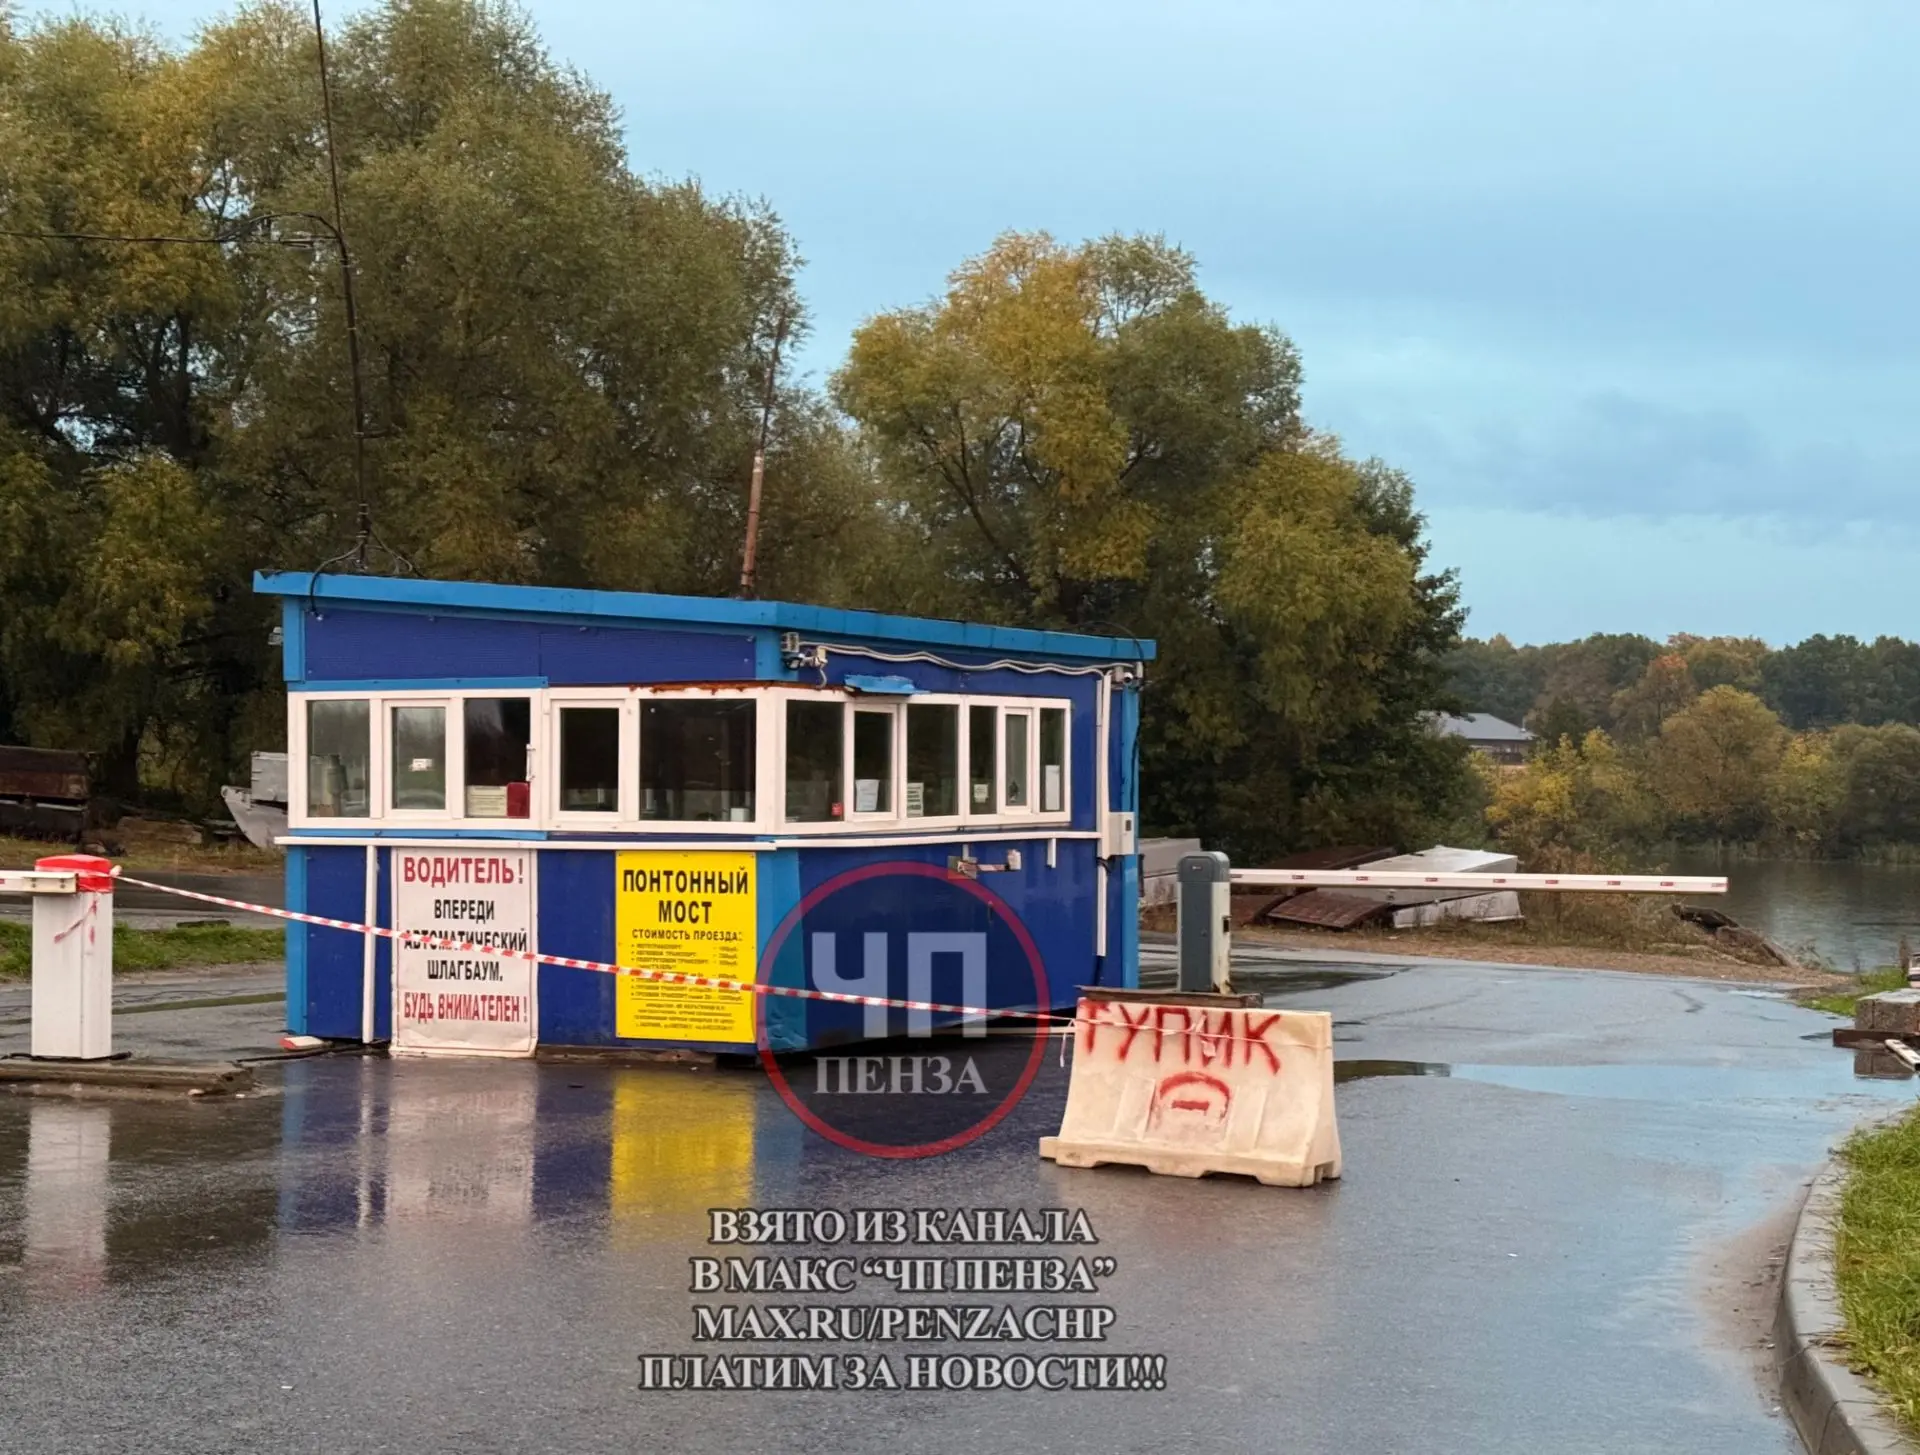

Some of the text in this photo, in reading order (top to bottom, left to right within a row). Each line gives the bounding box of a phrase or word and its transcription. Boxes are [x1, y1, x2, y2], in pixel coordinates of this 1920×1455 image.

[404, 857, 524, 887] ВОДИТЕЛЬ!
[623, 866, 748, 894] ПОНТОННЫЙ
[434, 899, 495, 924] ВПЕРЕДИ
[658, 900, 712, 924] МОСТ
[632, 929, 743, 942] СТОИМОСТЬ ПРОЕЗДА:
[427, 959, 503, 981] ШЛАГБАУМ.
[404, 992, 434, 1024] БУДЬ
[1079, 1000, 1281, 1075] ТУПИК
